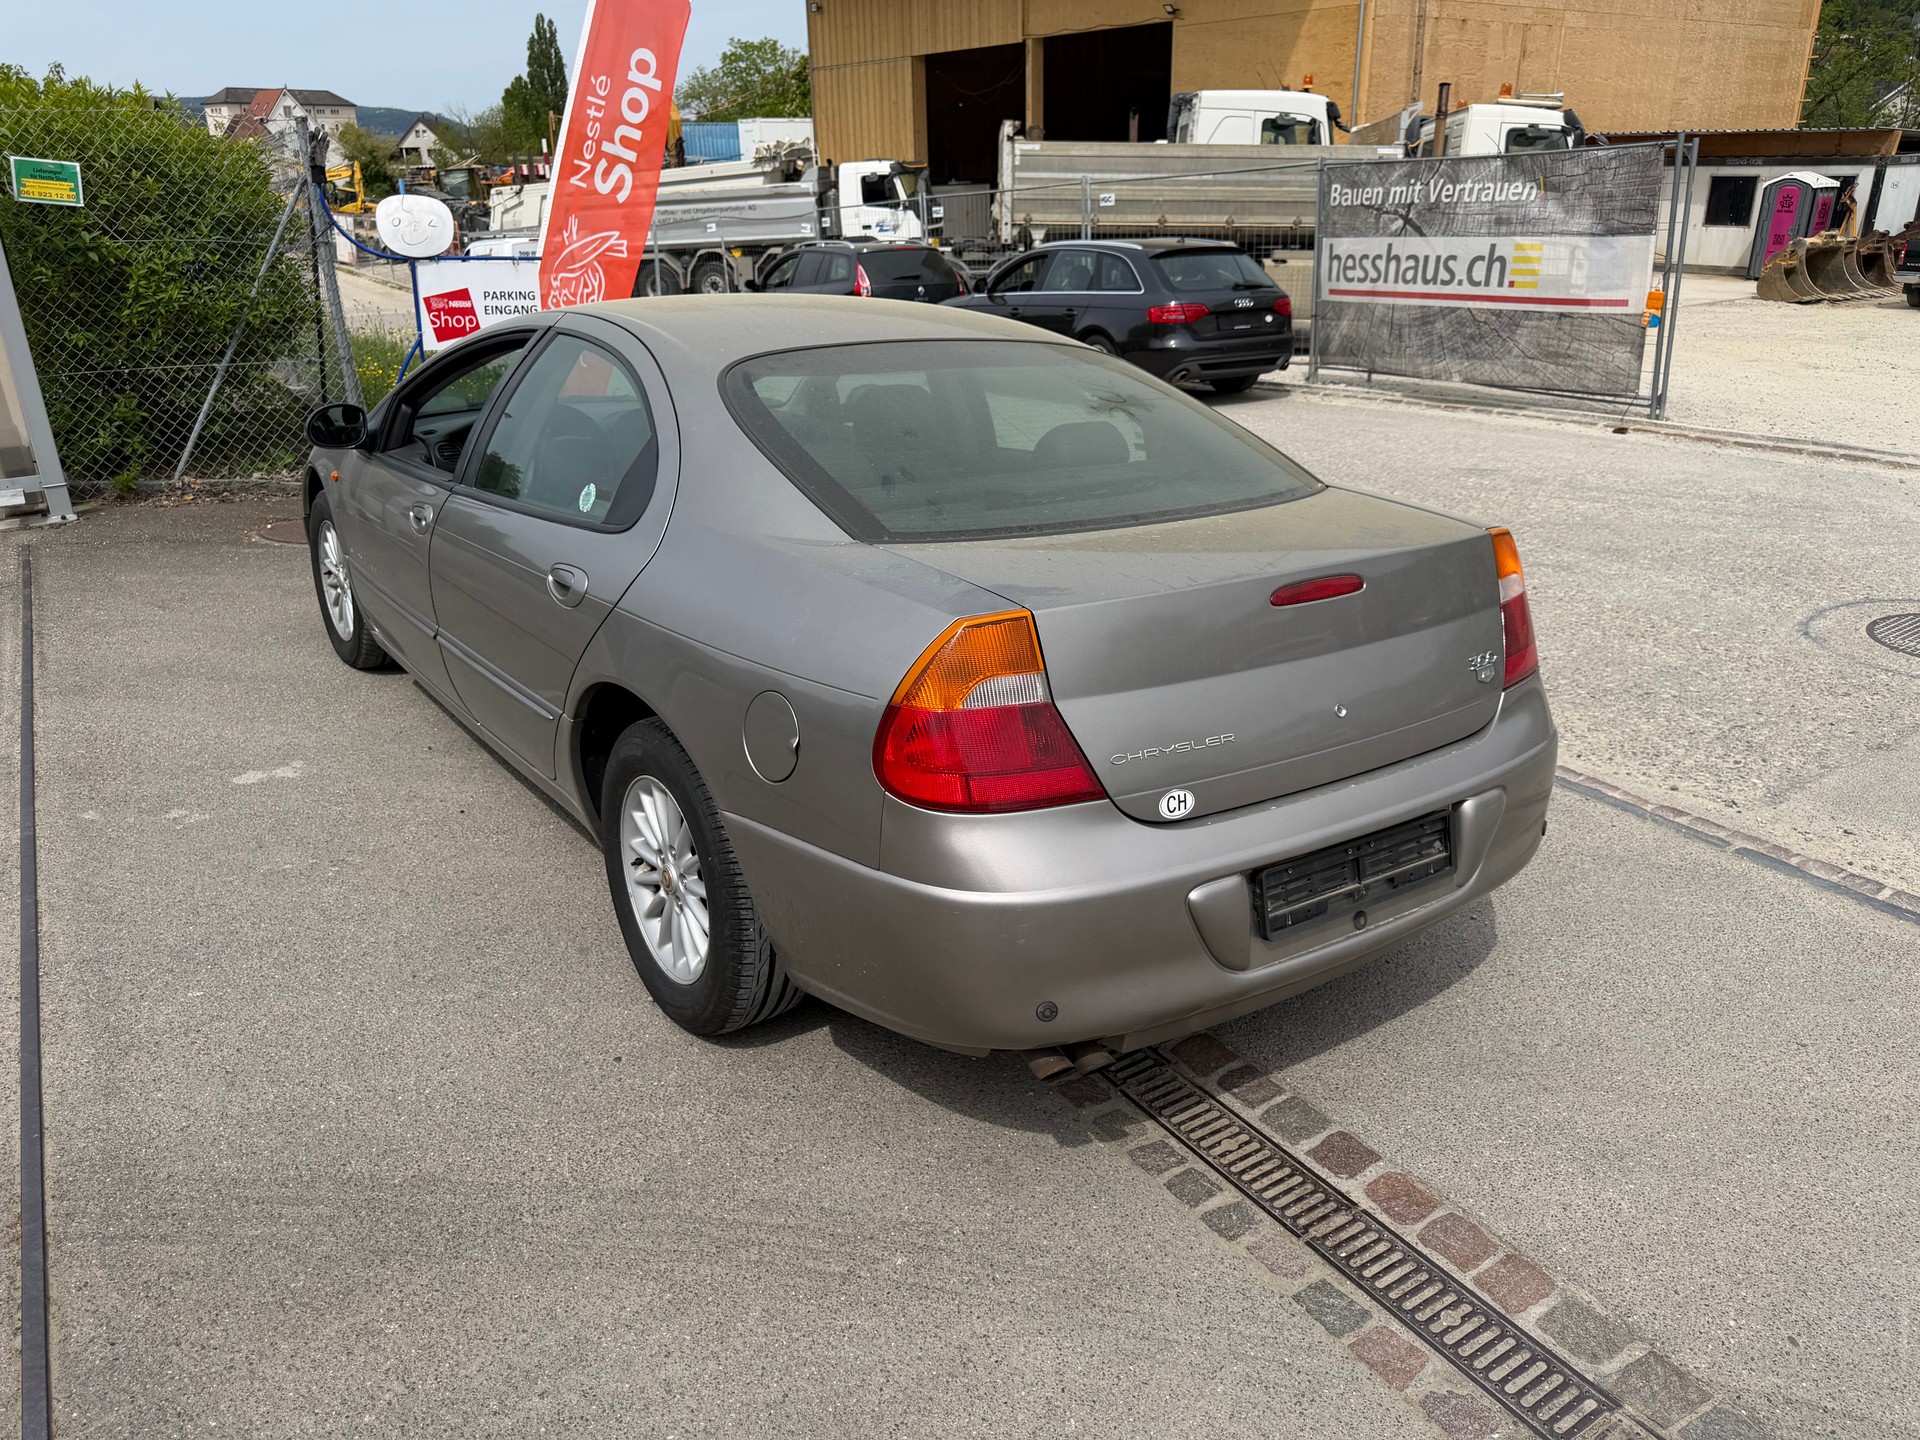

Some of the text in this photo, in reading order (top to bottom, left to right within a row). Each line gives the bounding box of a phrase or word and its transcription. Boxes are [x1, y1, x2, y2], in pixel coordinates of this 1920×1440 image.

[569, 75, 611, 188] Nestlé
[594, 47, 662, 204] Shop
[1330, 184, 1383, 207] Bauen
[1388, 179, 1423, 204] mit
[1327, 243, 1507, 288] hesshaus.ch
[483, 290, 536, 301] PARKING
[484, 304, 538, 315] EINGANG
[430, 311, 477, 332] Shop
[1110, 733, 1236, 765] CHRYSLER
[1166, 793, 1188, 814] CH
